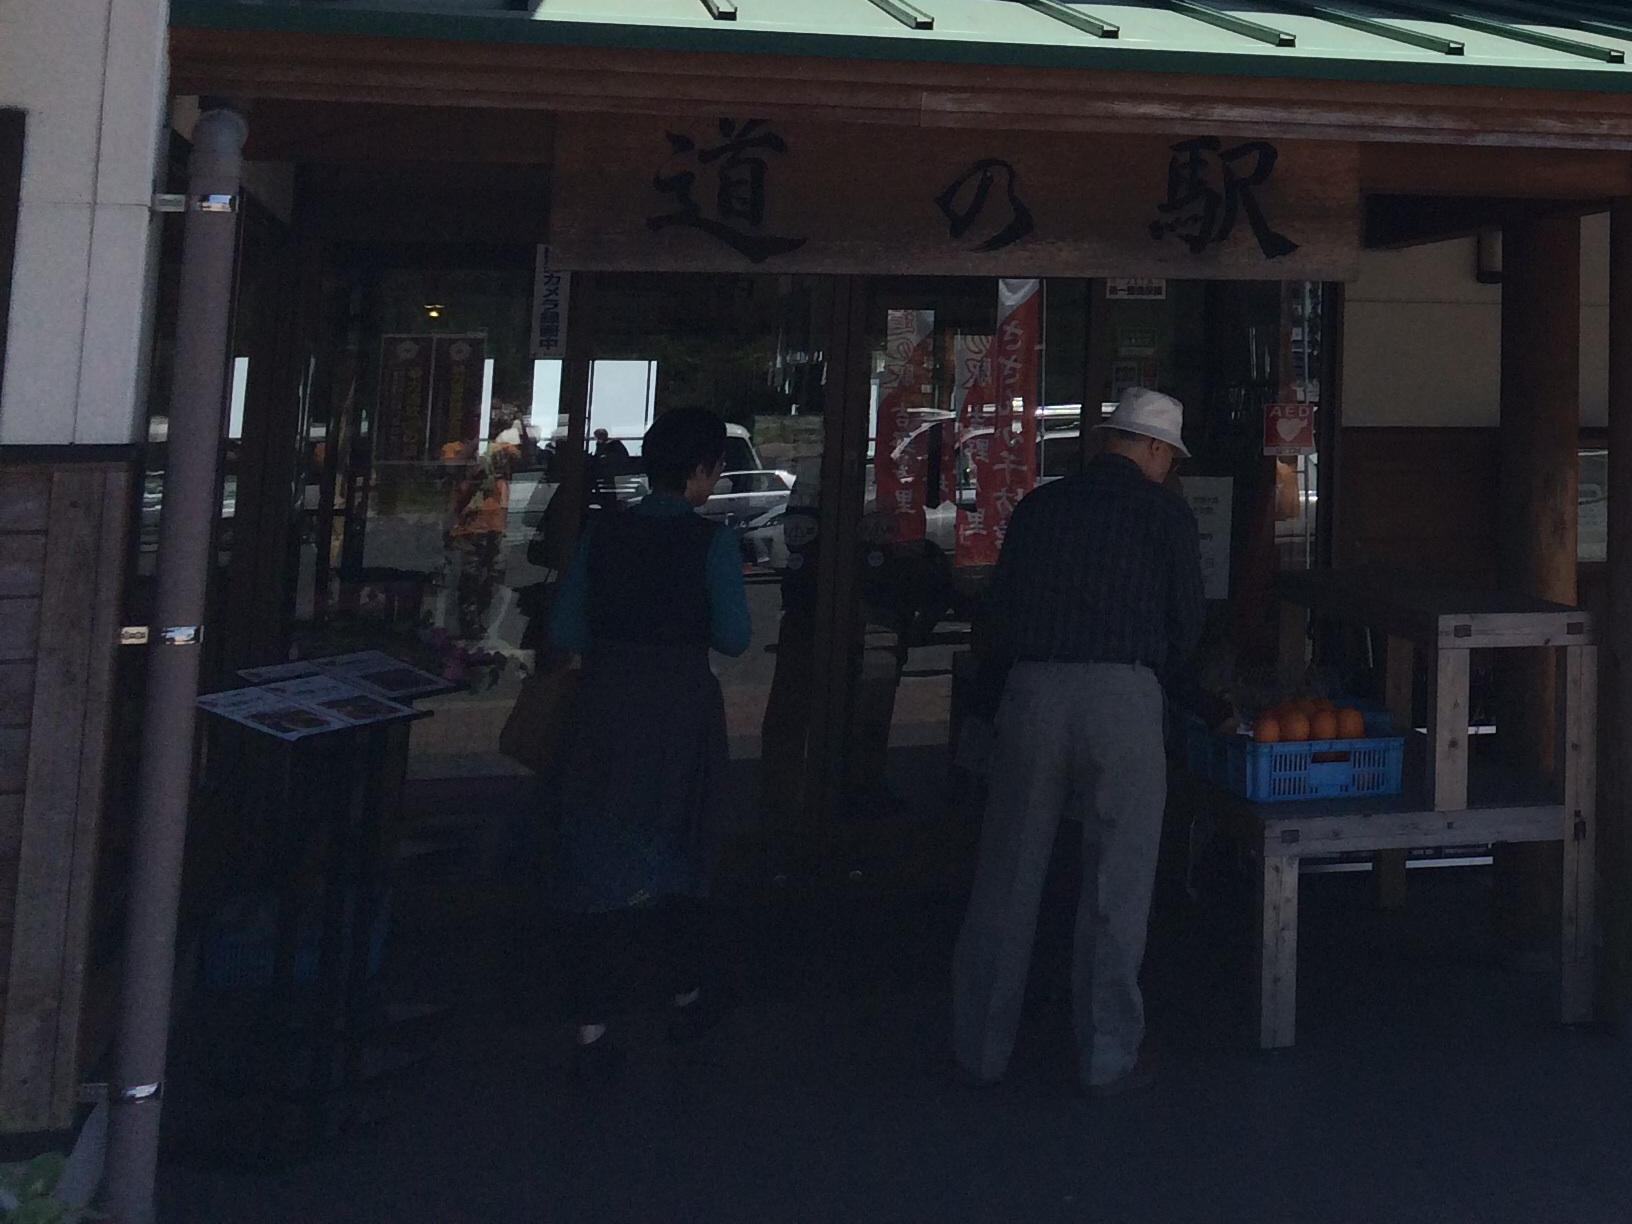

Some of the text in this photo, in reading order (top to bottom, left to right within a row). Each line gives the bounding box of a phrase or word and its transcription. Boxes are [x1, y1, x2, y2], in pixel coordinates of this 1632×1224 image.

[646, 117, 1300, 263] 道の駅
[1270, 407, 1310, 417] AED
